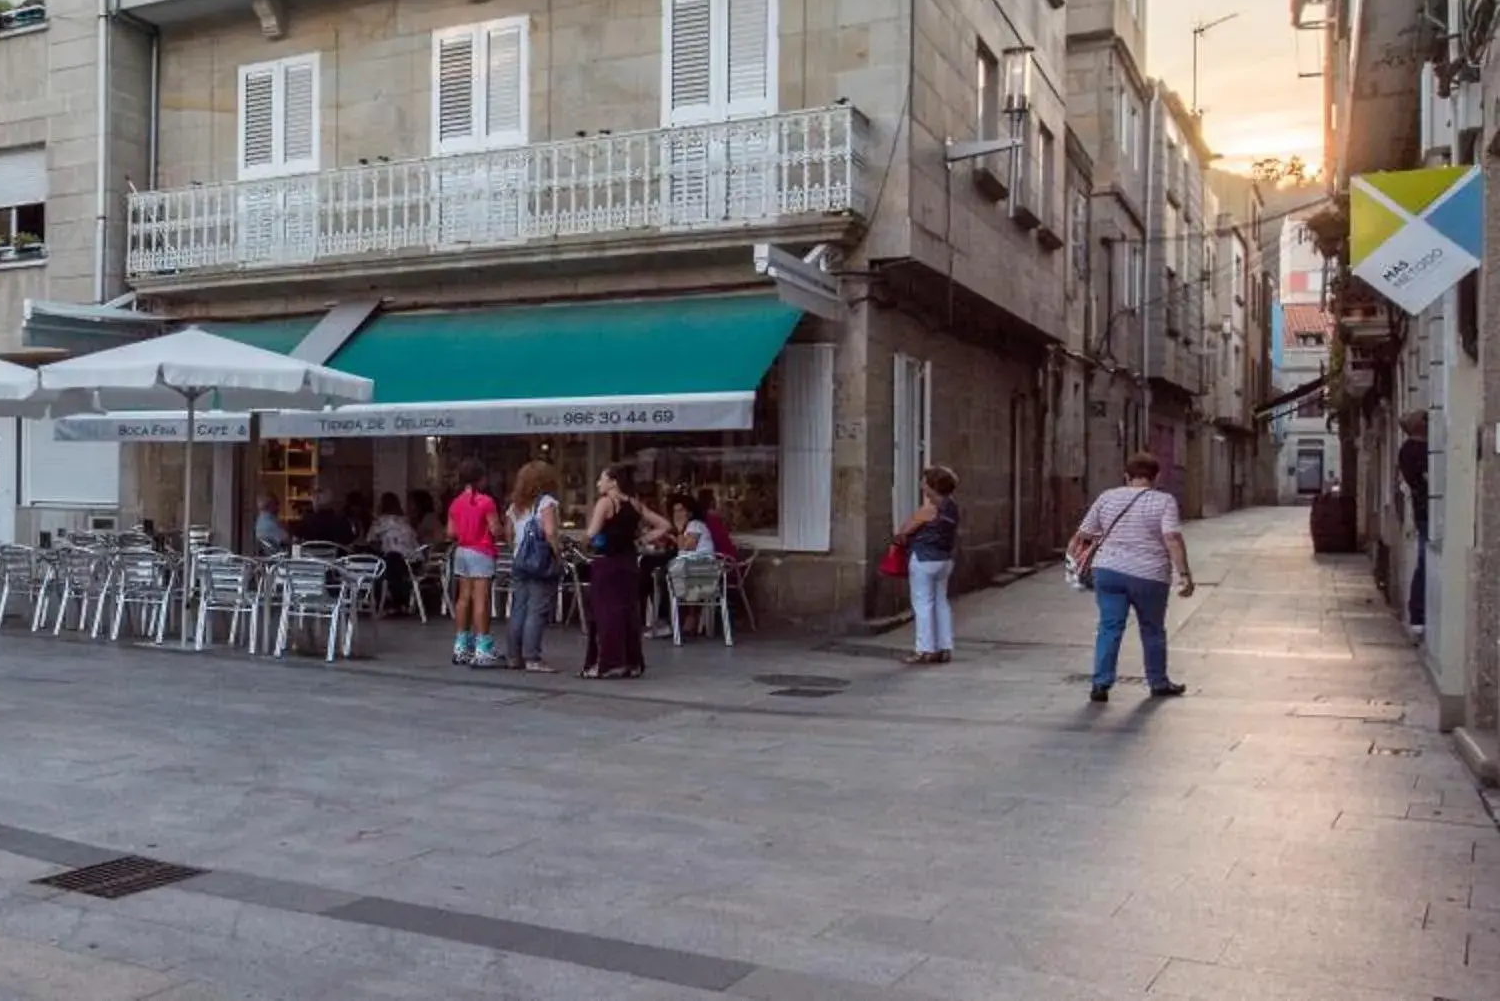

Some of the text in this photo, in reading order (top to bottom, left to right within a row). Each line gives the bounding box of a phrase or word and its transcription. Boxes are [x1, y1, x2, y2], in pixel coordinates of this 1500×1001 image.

[366, 417, 385, 430] DE
[563, 411, 595, 425] 986
[598, 410, 621, 425] 30
[626, 410, 647, 424] 44
[652, 409, 674, 424] 69
[118, 424, 149, 436] BOCA
